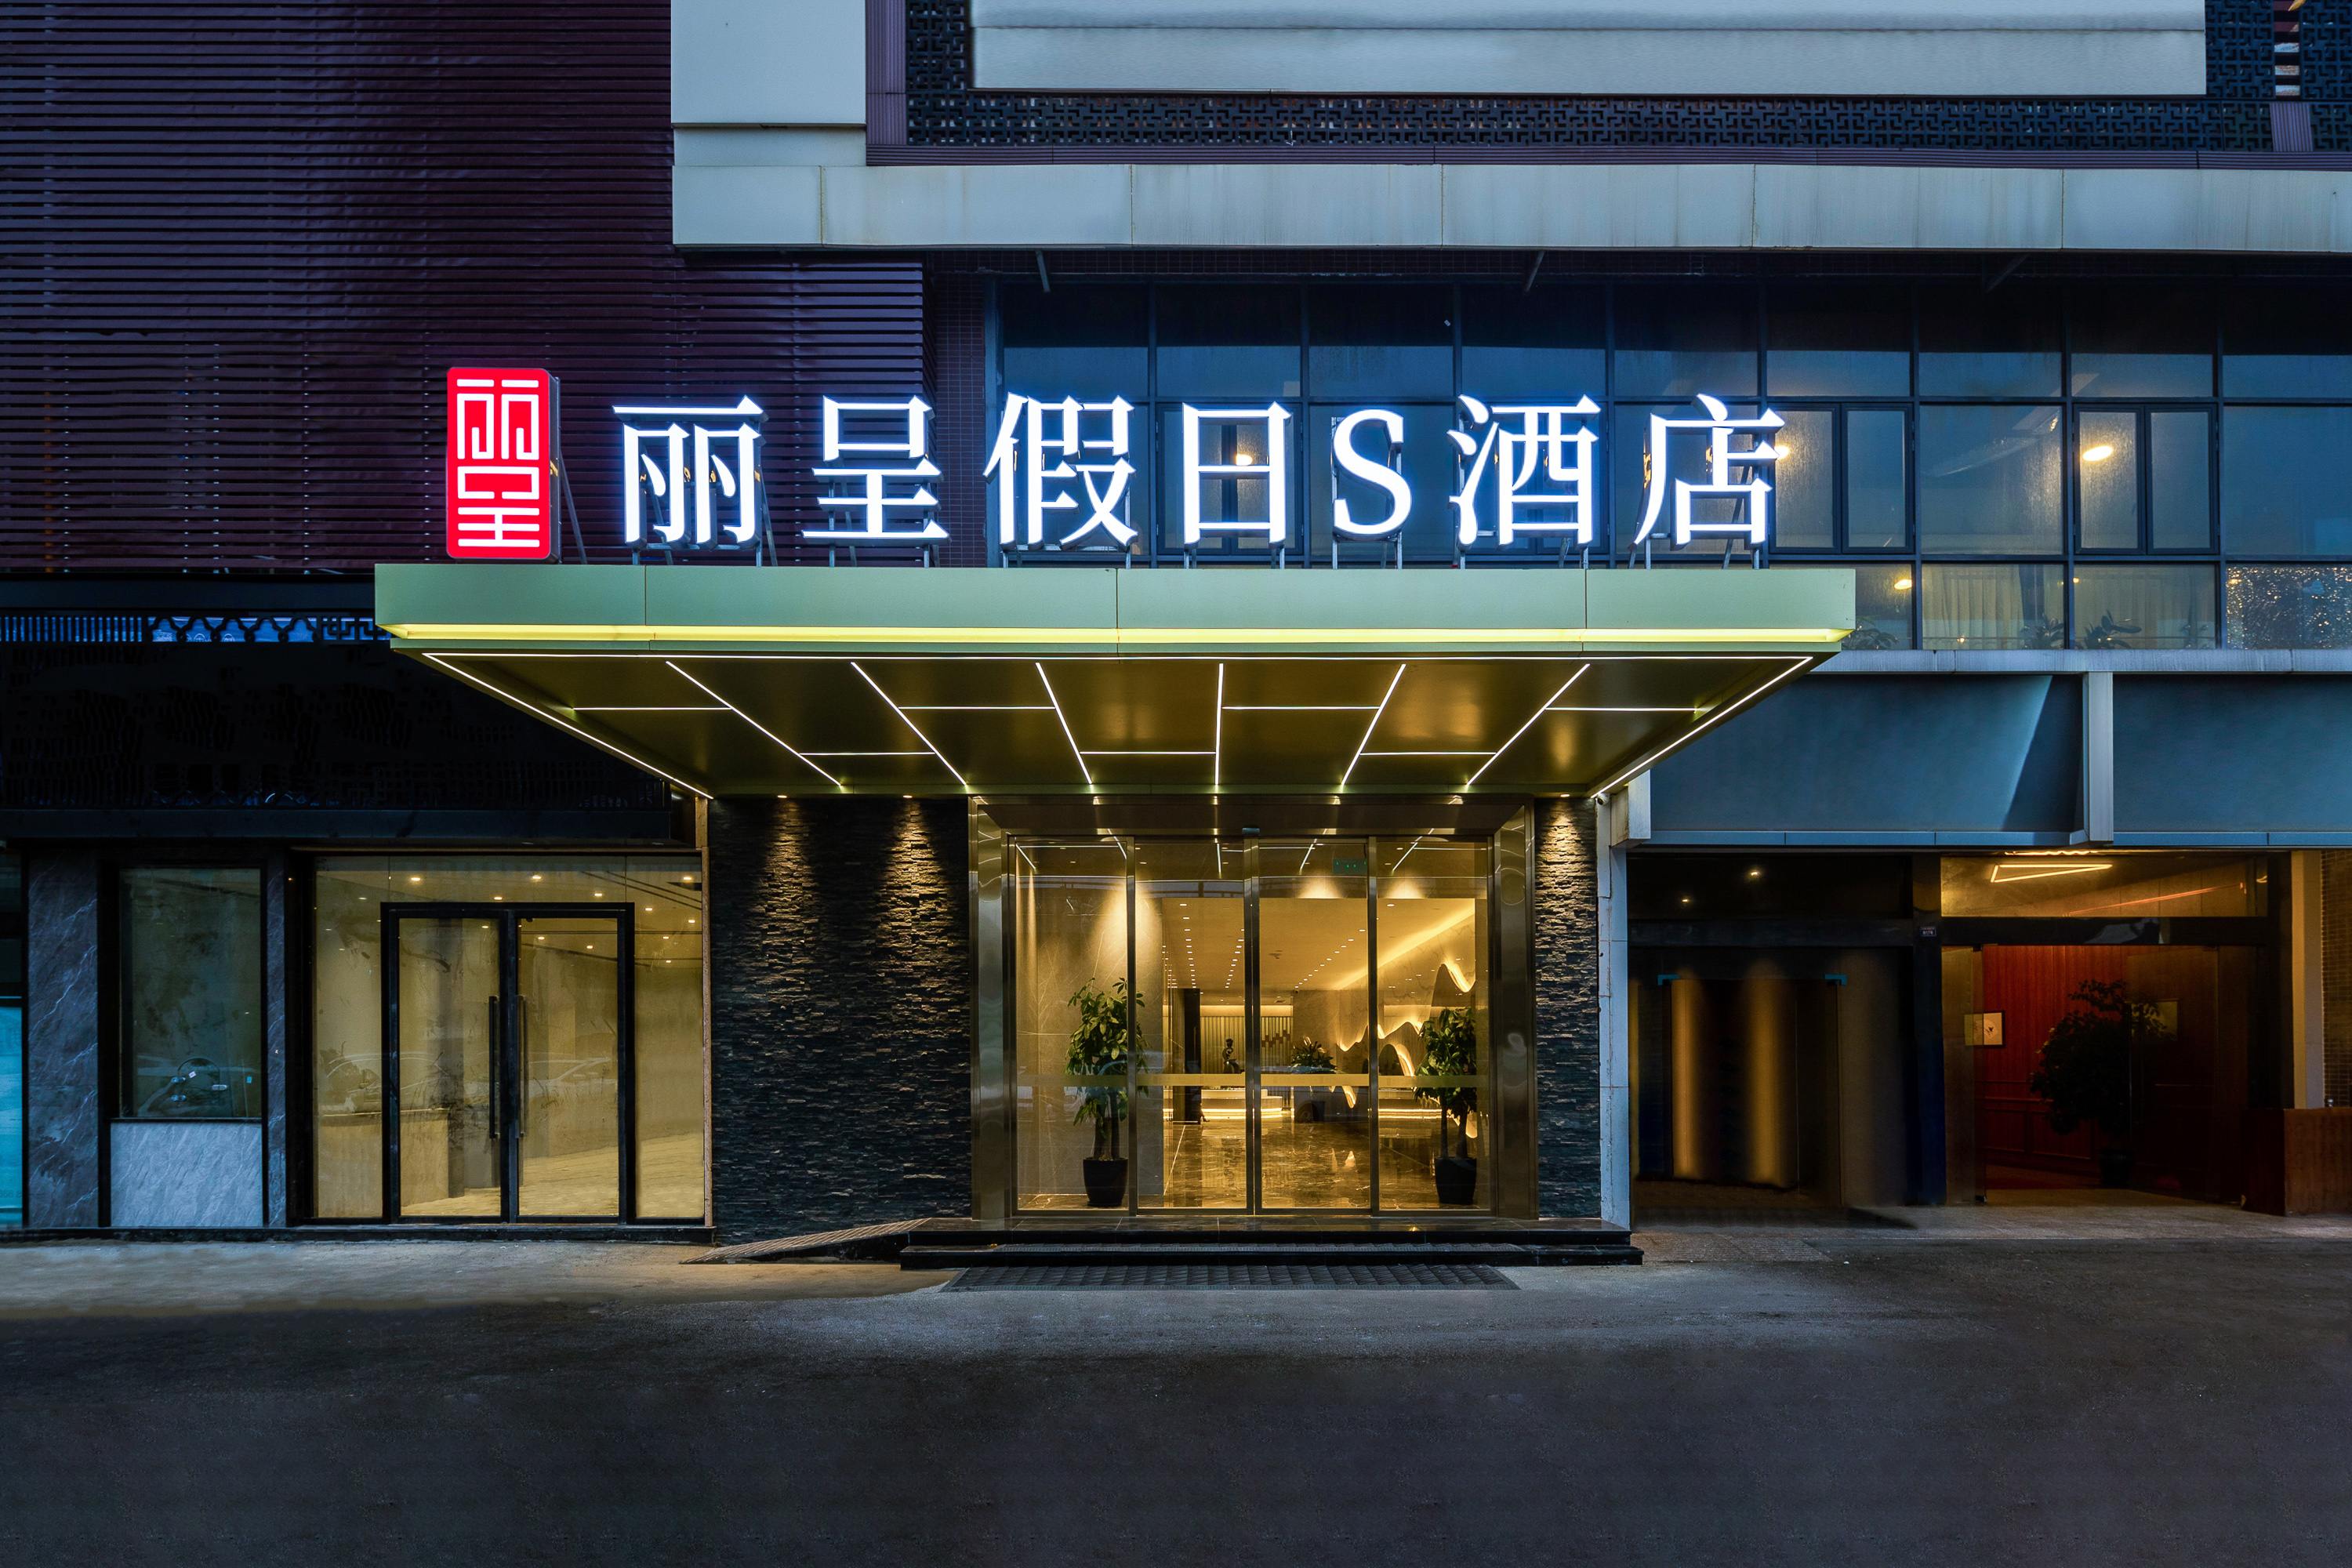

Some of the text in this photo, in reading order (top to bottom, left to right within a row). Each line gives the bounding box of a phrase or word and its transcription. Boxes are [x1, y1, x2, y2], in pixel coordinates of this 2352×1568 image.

[456, 379, 540, 548] 丽呈
[612, 393, 1786, 548] 丽呈假日S酒店
